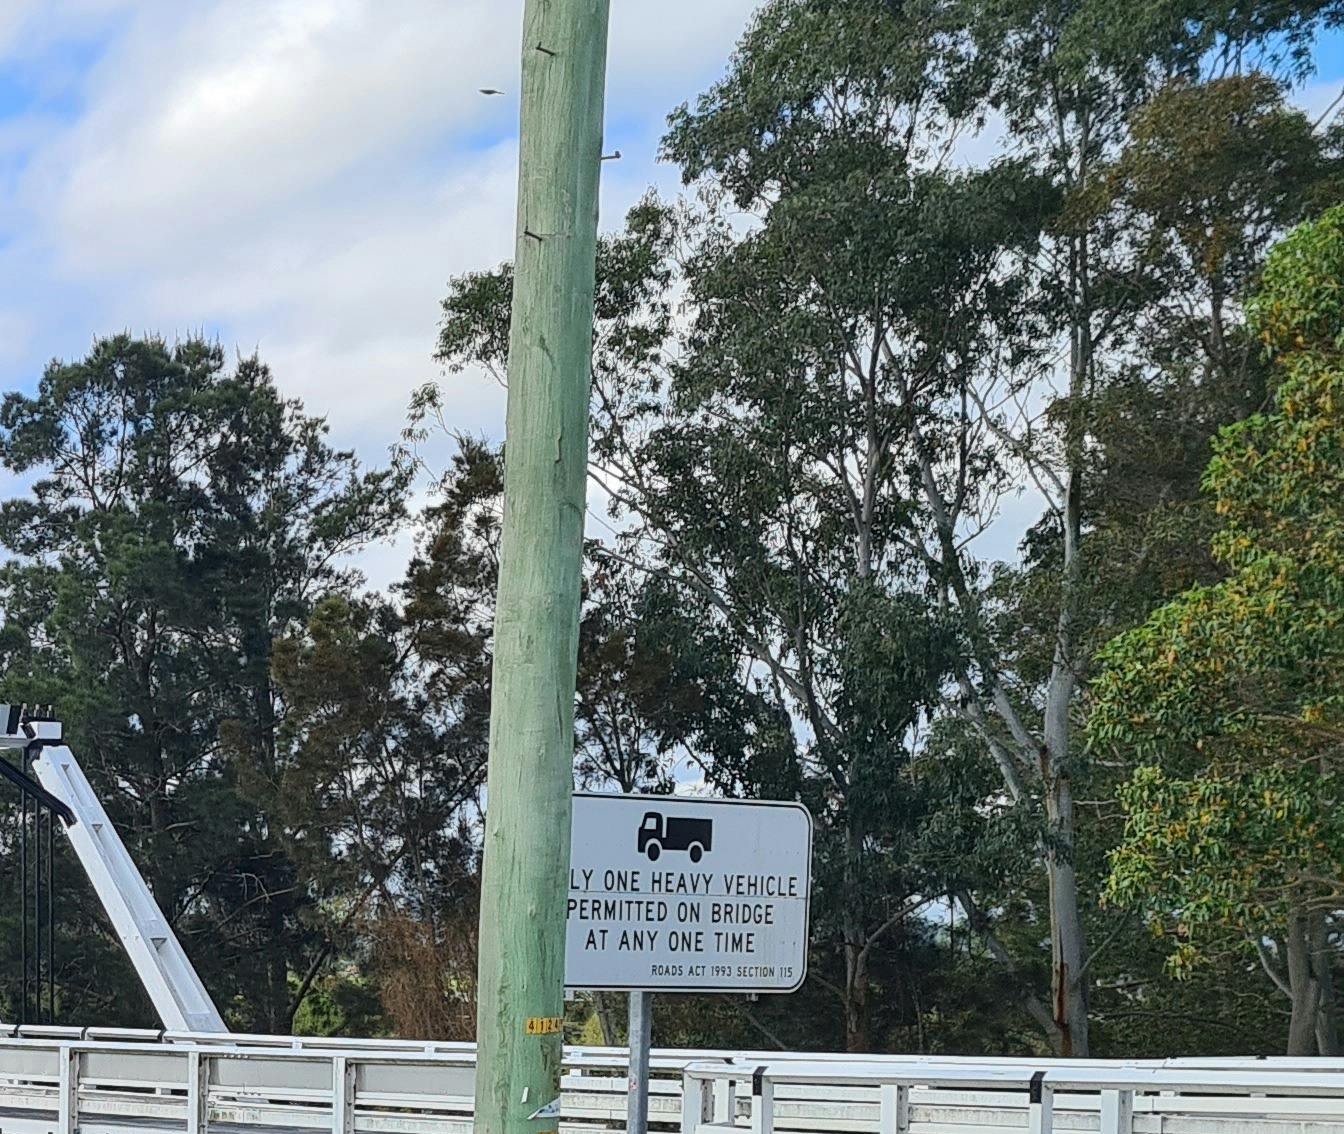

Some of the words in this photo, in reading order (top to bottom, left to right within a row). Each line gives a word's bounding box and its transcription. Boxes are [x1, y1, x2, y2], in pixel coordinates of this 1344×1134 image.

[570, 868, 593, 890] LY
[604, 870, 640, 892] ONE
[651, 872, 714, 894] HEAVY
[724, 874, 798, 897] VEHICLE
[566, 899, 668, 922] PERMITTED
[677, 902, 700, 923] ON
[712, 903, 774, 925] BRIDGE
[584, 929, 609, 950] AT
[619, 930, 659, 951] ANY
[668, 931, 704, 952] ONE
[714, 932, 755, 953] TIME
[651, 965, 683, 977] ROADS
[688, 966, 706, 977] ACT
[711, 966, 732, 977] 1993
[737, 966, 775, 978] SECTION
[780, 967, 793, 978] 115
